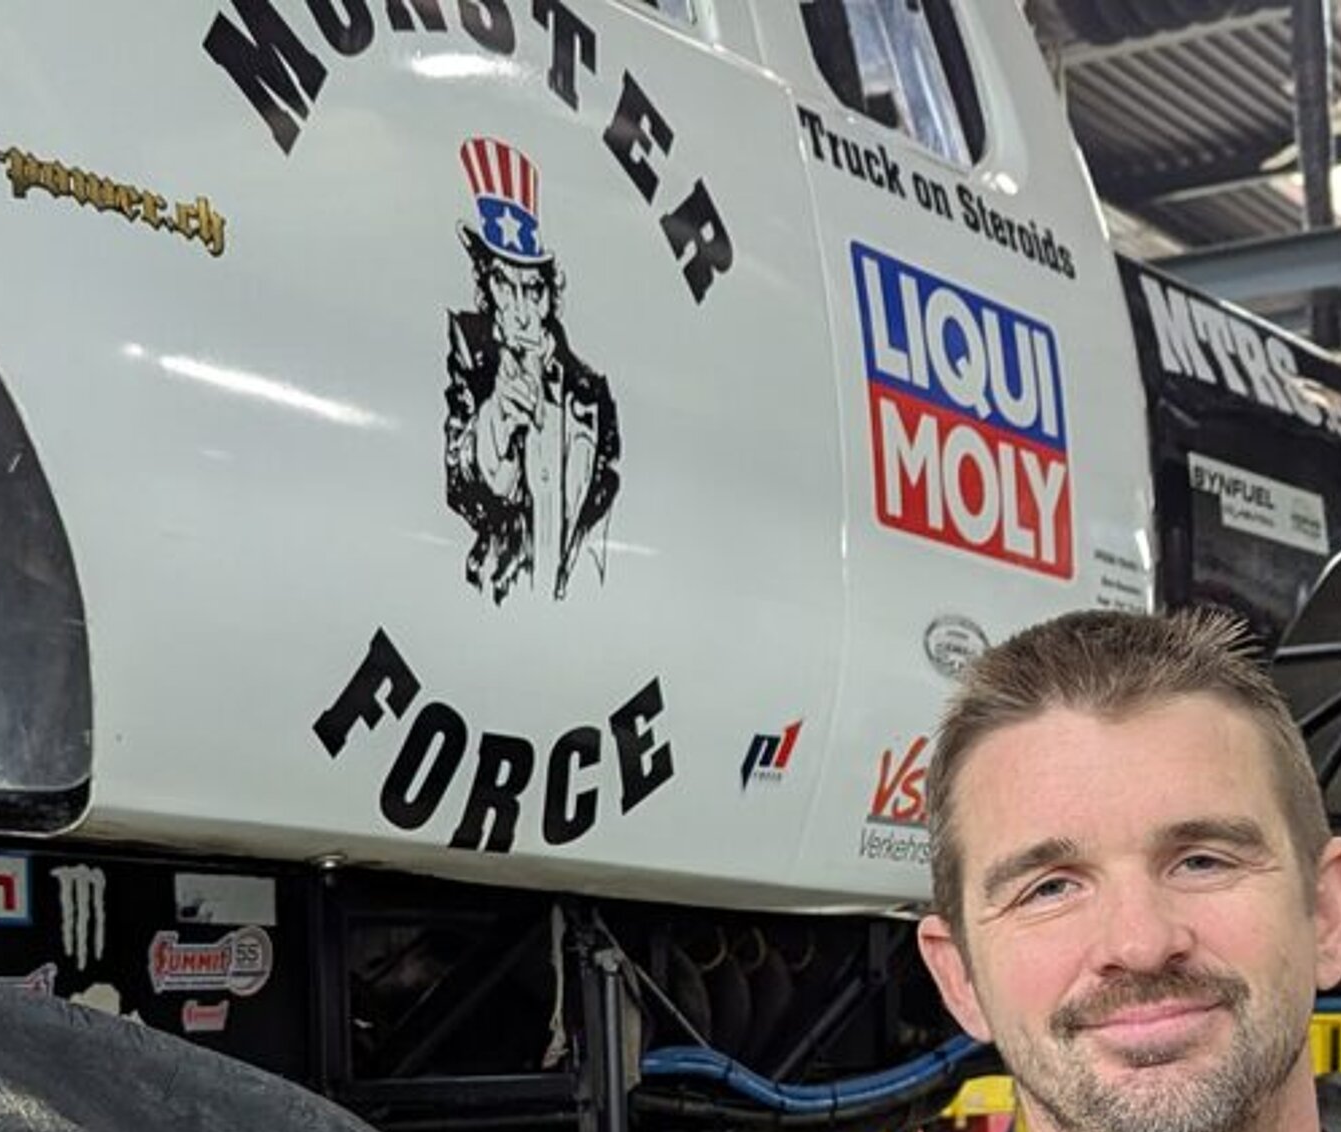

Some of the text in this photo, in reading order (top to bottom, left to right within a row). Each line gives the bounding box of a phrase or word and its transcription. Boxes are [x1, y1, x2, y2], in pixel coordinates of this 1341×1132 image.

[797, 105, 1076, 280] Truck on Steroids
[861, 255, 1058, 439] LIQUI
[879, 395, 1067, 566] MOLY
[311, 626, 675, 855] FORCE
[858, 827, 934, 866] Verkehrs
